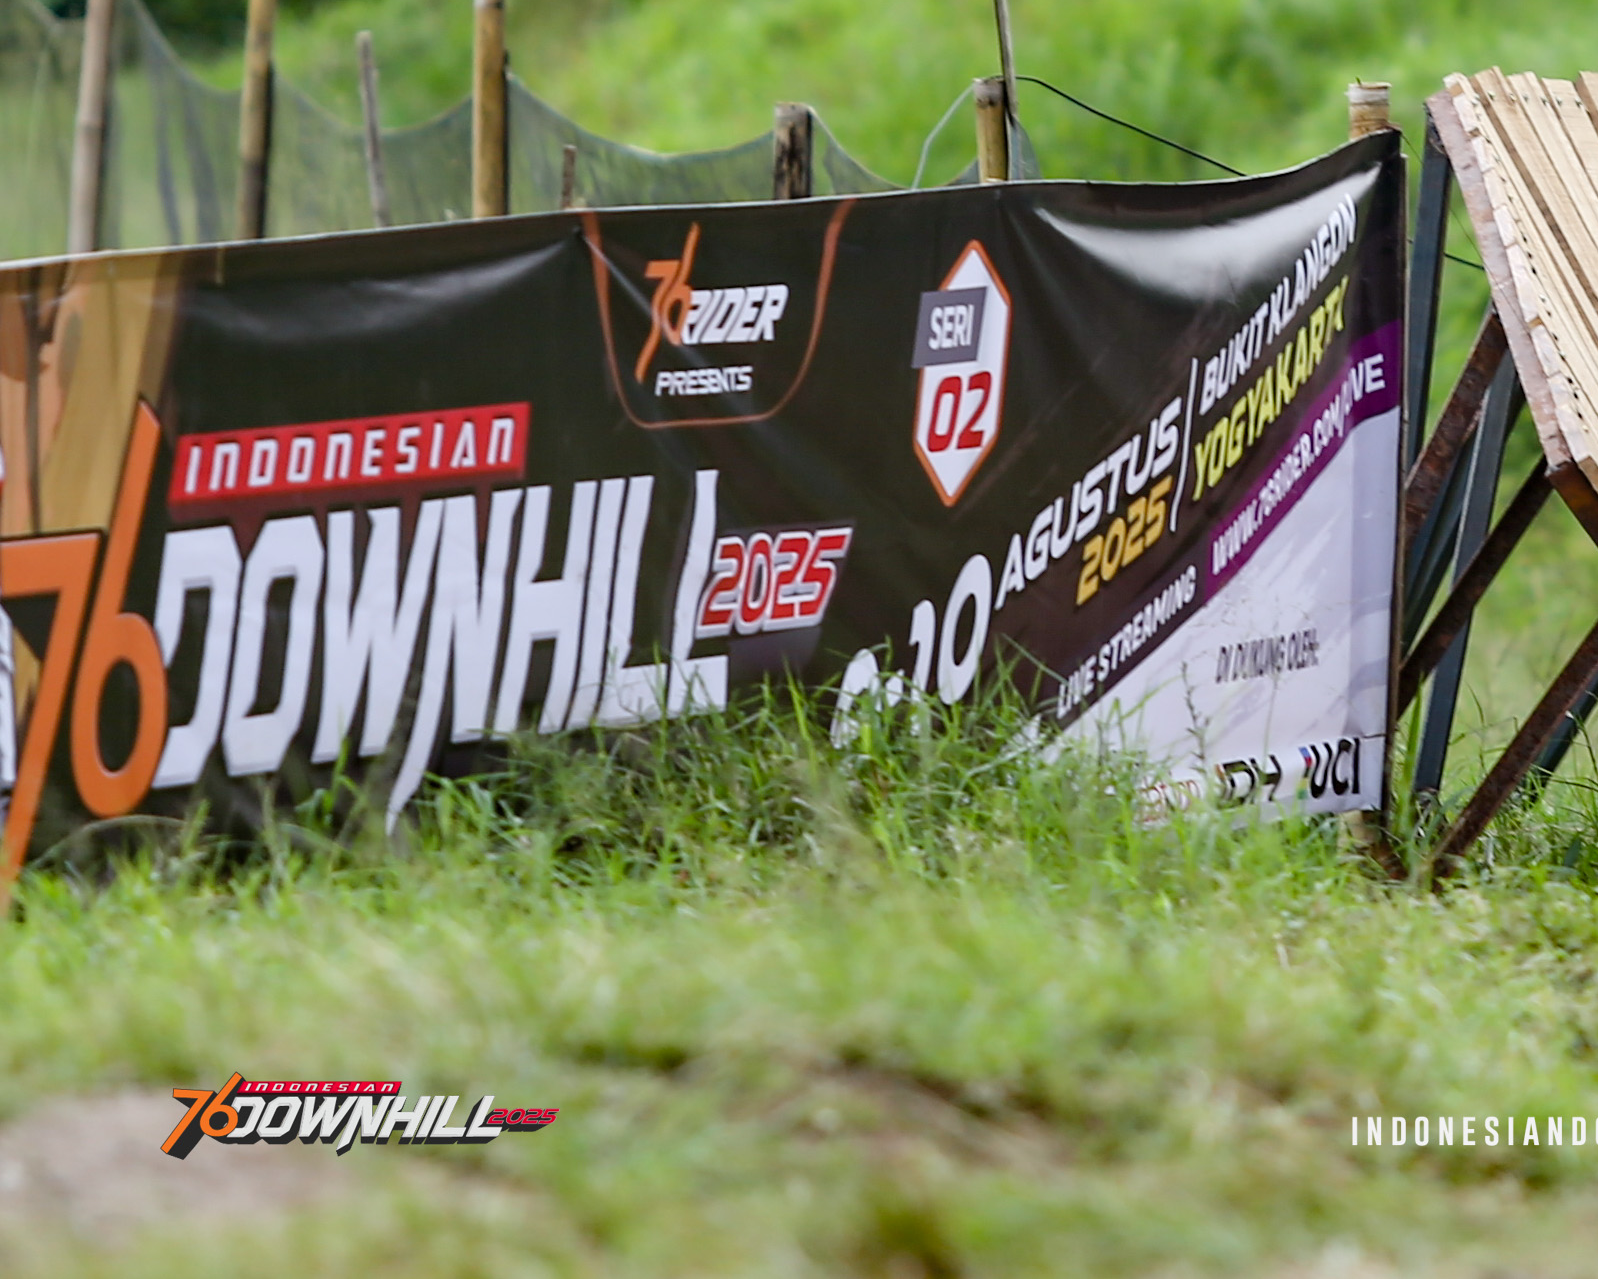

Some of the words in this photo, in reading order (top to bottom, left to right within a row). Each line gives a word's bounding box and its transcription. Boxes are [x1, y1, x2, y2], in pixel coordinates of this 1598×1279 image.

[928, 302, 975, 352] SERI
[1199, 302, 1269, 416] BUKIT
[655, 365, 753, 397] PRESENTS
[926, 370, 993, 453] 02
[184, 416, 517, 495] INDONESIAN
[995, 397, 1182, 611] AGUSTUS
[698, 526, 854, 639] 2025
[1076, 474, 1173, 606] 2025
[1057, 654, 1096, 720] LIVE
[1098, 565, 1197, 682] STREAMING
[1309, 736, 1361, 799] UCI
